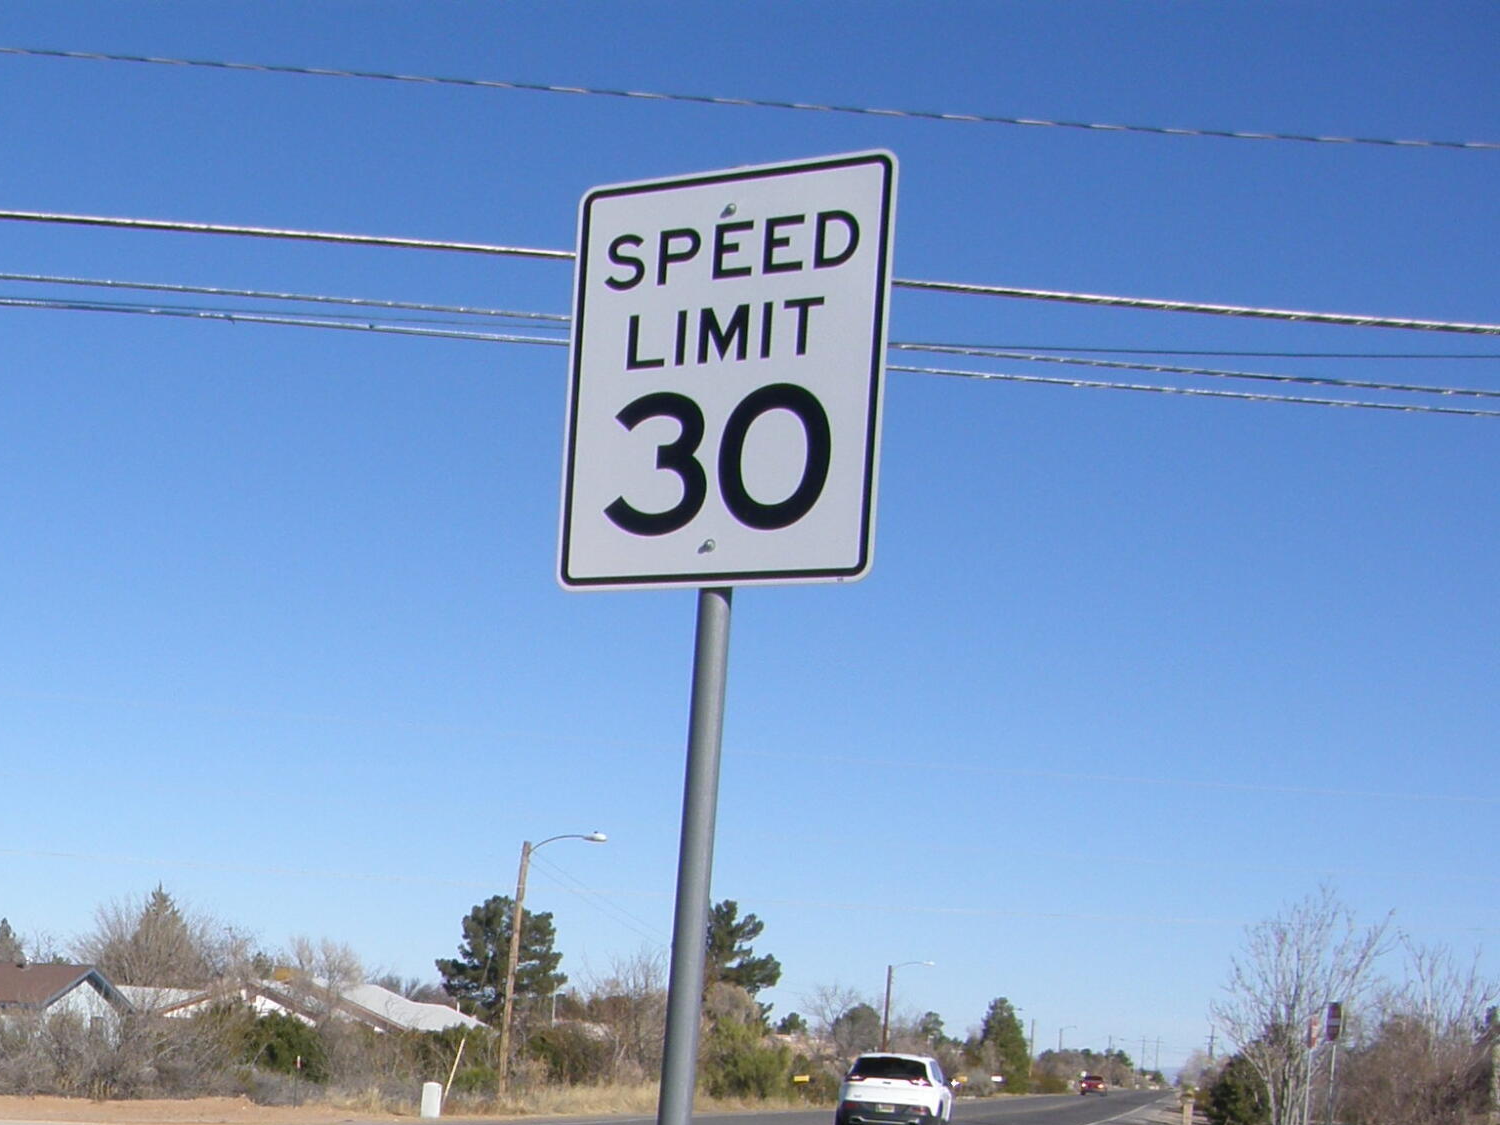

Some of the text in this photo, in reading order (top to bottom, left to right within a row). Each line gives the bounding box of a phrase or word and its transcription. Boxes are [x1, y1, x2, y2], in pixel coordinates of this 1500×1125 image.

[603, 209, 861, 292] SPEED
[625, 296, 825, 371] LIMIT
[603, 382, 832, 538] 30
